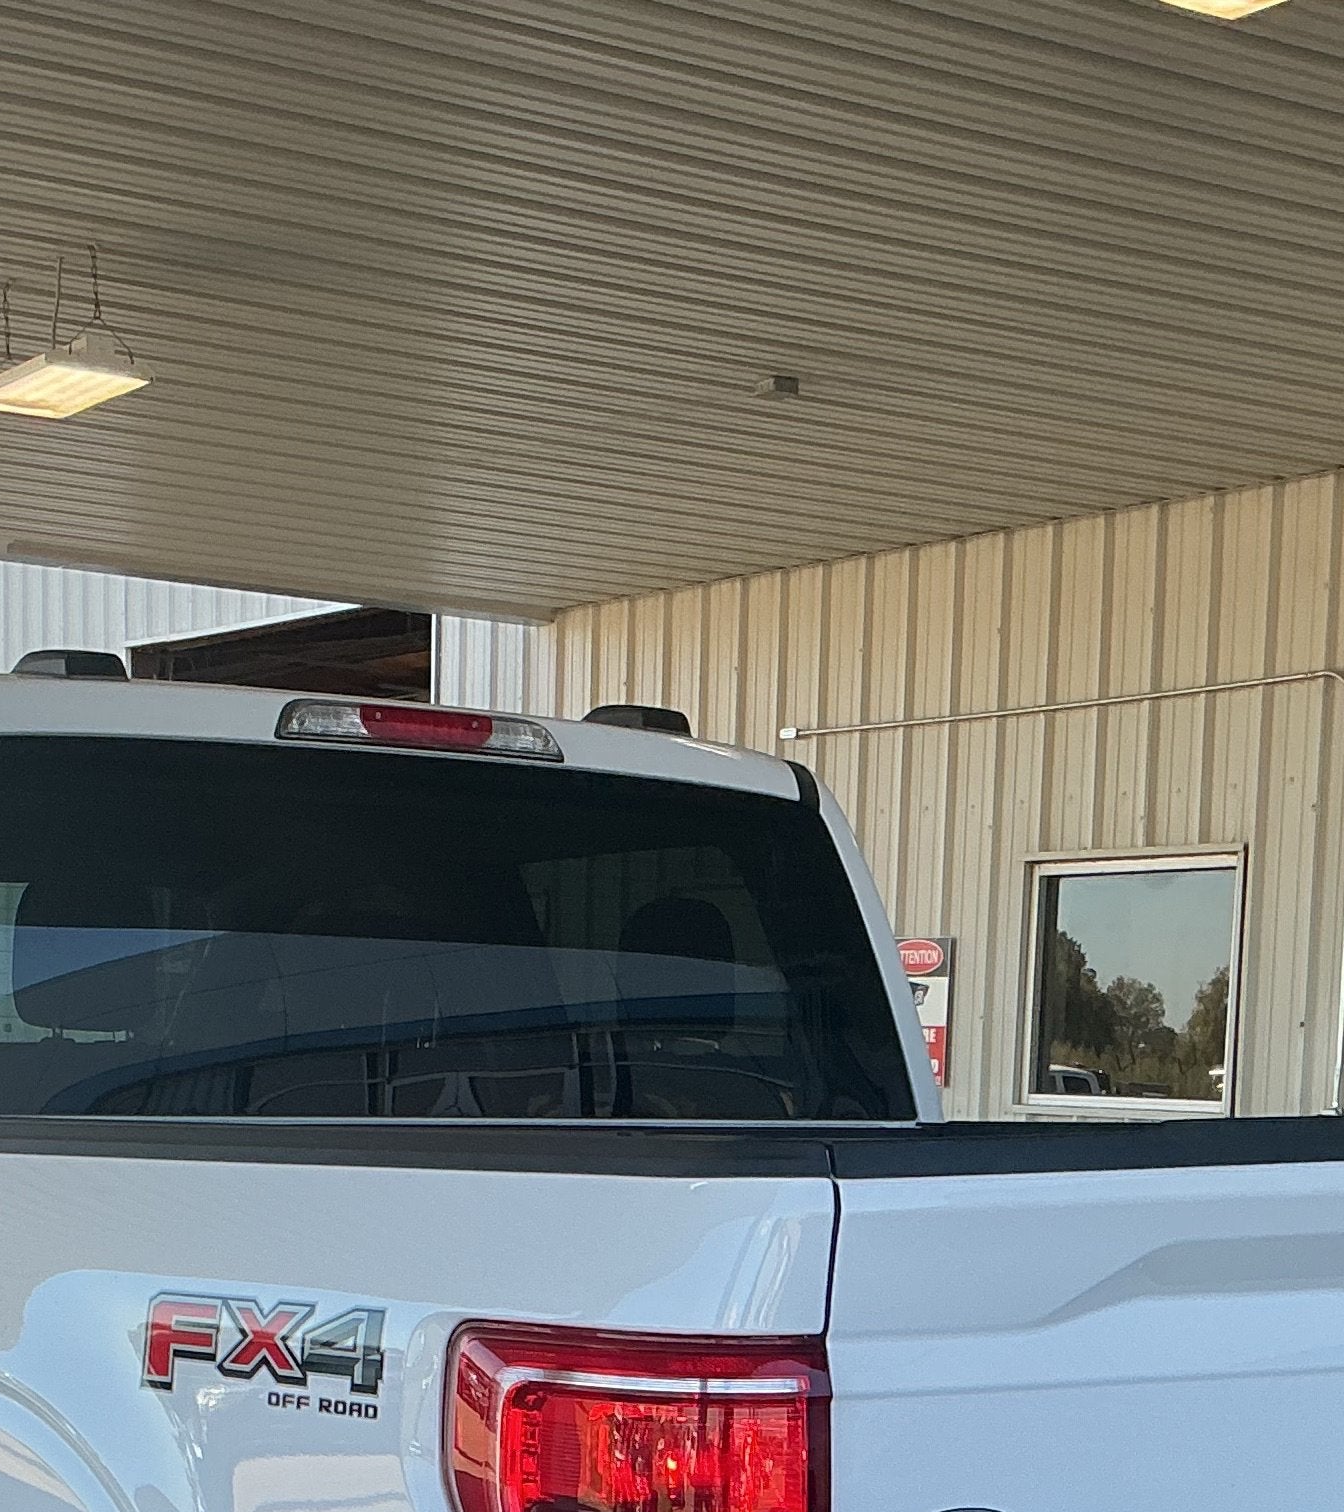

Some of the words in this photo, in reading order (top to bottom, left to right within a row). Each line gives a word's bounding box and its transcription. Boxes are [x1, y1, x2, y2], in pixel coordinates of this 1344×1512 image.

[899, 950, 939, 965] TTENTION
[143, 1292, 386, 1395] FX4
[267, 1392, 312, 1411] OFF
[318, 1398, 379, 1420] ROAD
